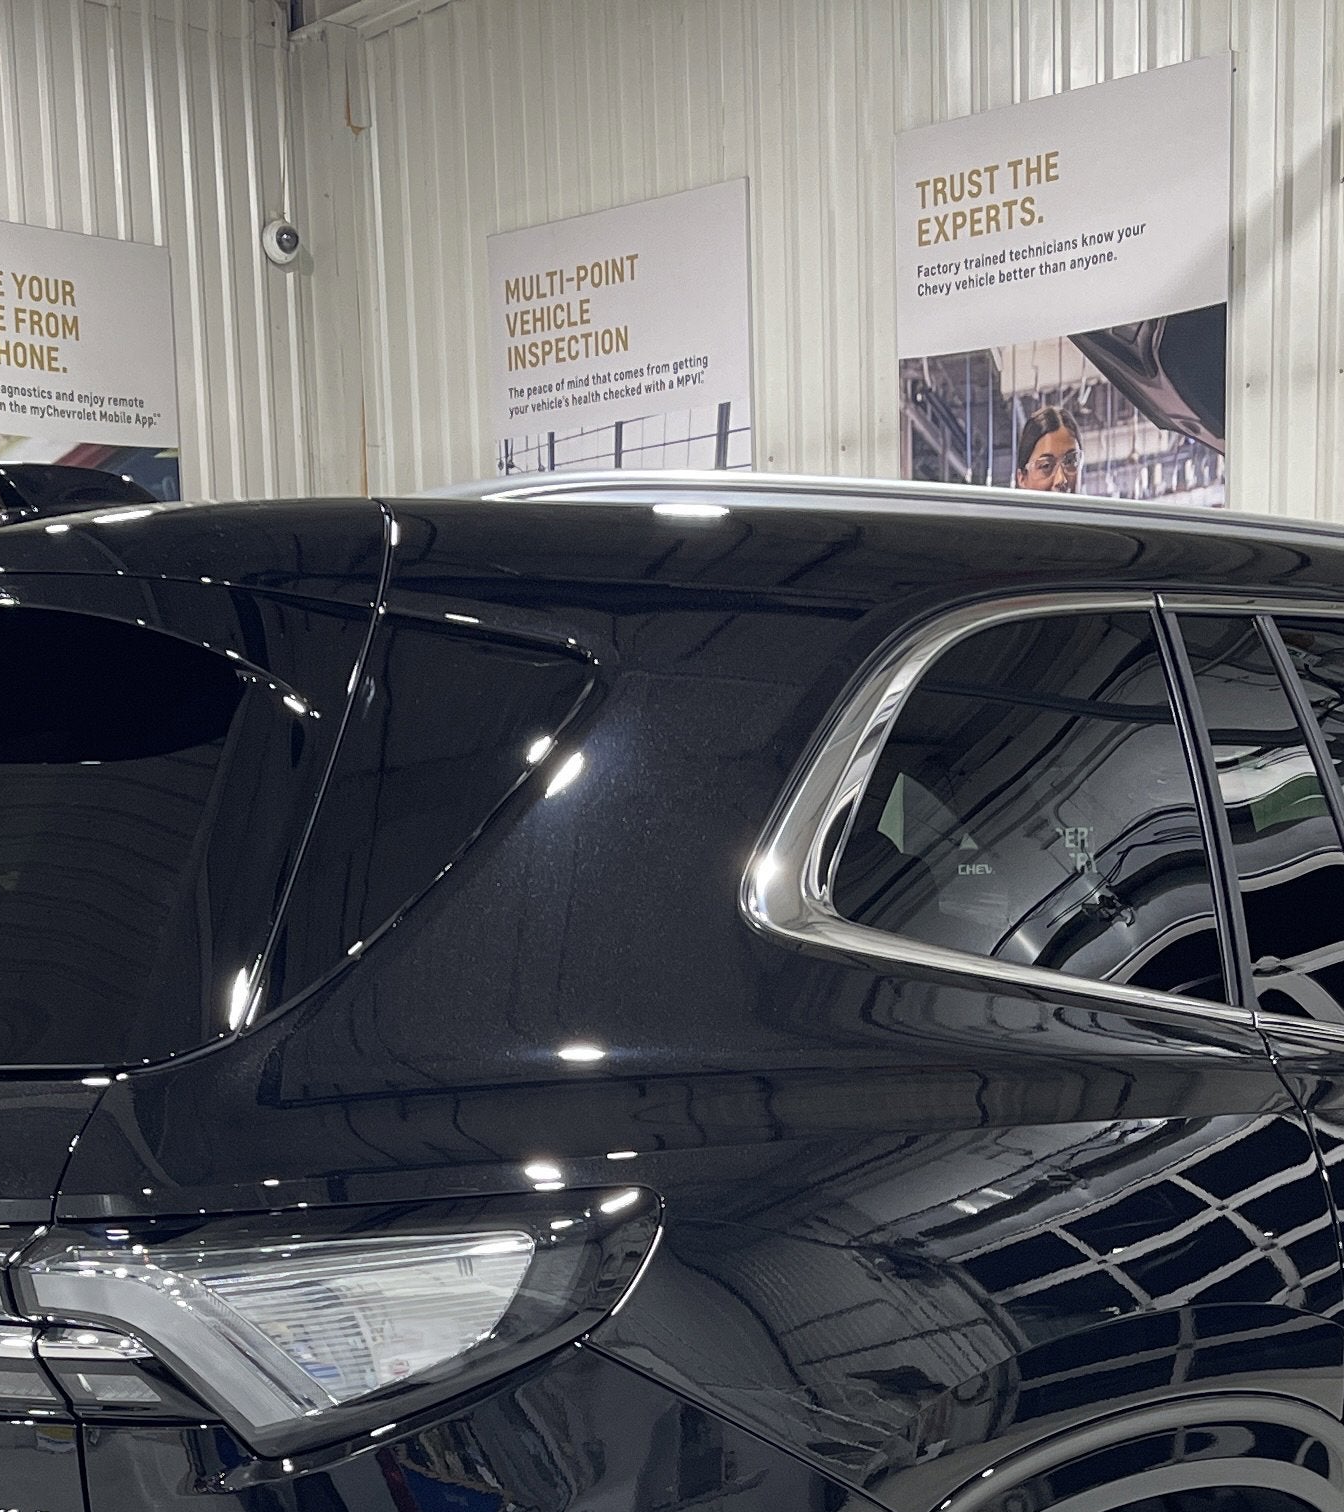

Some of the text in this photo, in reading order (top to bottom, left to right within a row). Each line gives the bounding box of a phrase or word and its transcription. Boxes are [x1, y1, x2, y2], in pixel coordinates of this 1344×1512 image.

[916, 151, 1060, 210] TRUST THE
[917, 196, 1044, 247] EXPERTS.
[917, 222, 1146, 278] Factory trained technicians know your
[11, 272, 76, 307] YOUR
[505, 254, 639, 304] MULTI-POINT
[917, 250, 1118, 297] Chevy vehicle better than anyone.
[14, 307, 80, 341] FROM
[506, 298, 591, 338] VEHICLE
[507, 325, 629, 371] INSPECTION
[55, 390, 74, 402] and
[77, 392, 104, 407] enjoy
[108, 397, 144, 408] remote
[508, 354, 708, 399] The peace of mind that comes from getting
[509, 404, 529, 419] your
[531, 395, 569, 413] vehicle's
[572, 390, 600, 406] health
[603, 383, 642, 401] checked
[644, 379, 665, 394] with
[668, 380, 674, 389] a
[9, 400, 27, 414] the
[30, 404, 97, 421] myChevrolet
[99, 410, 132, 424] Mobile
